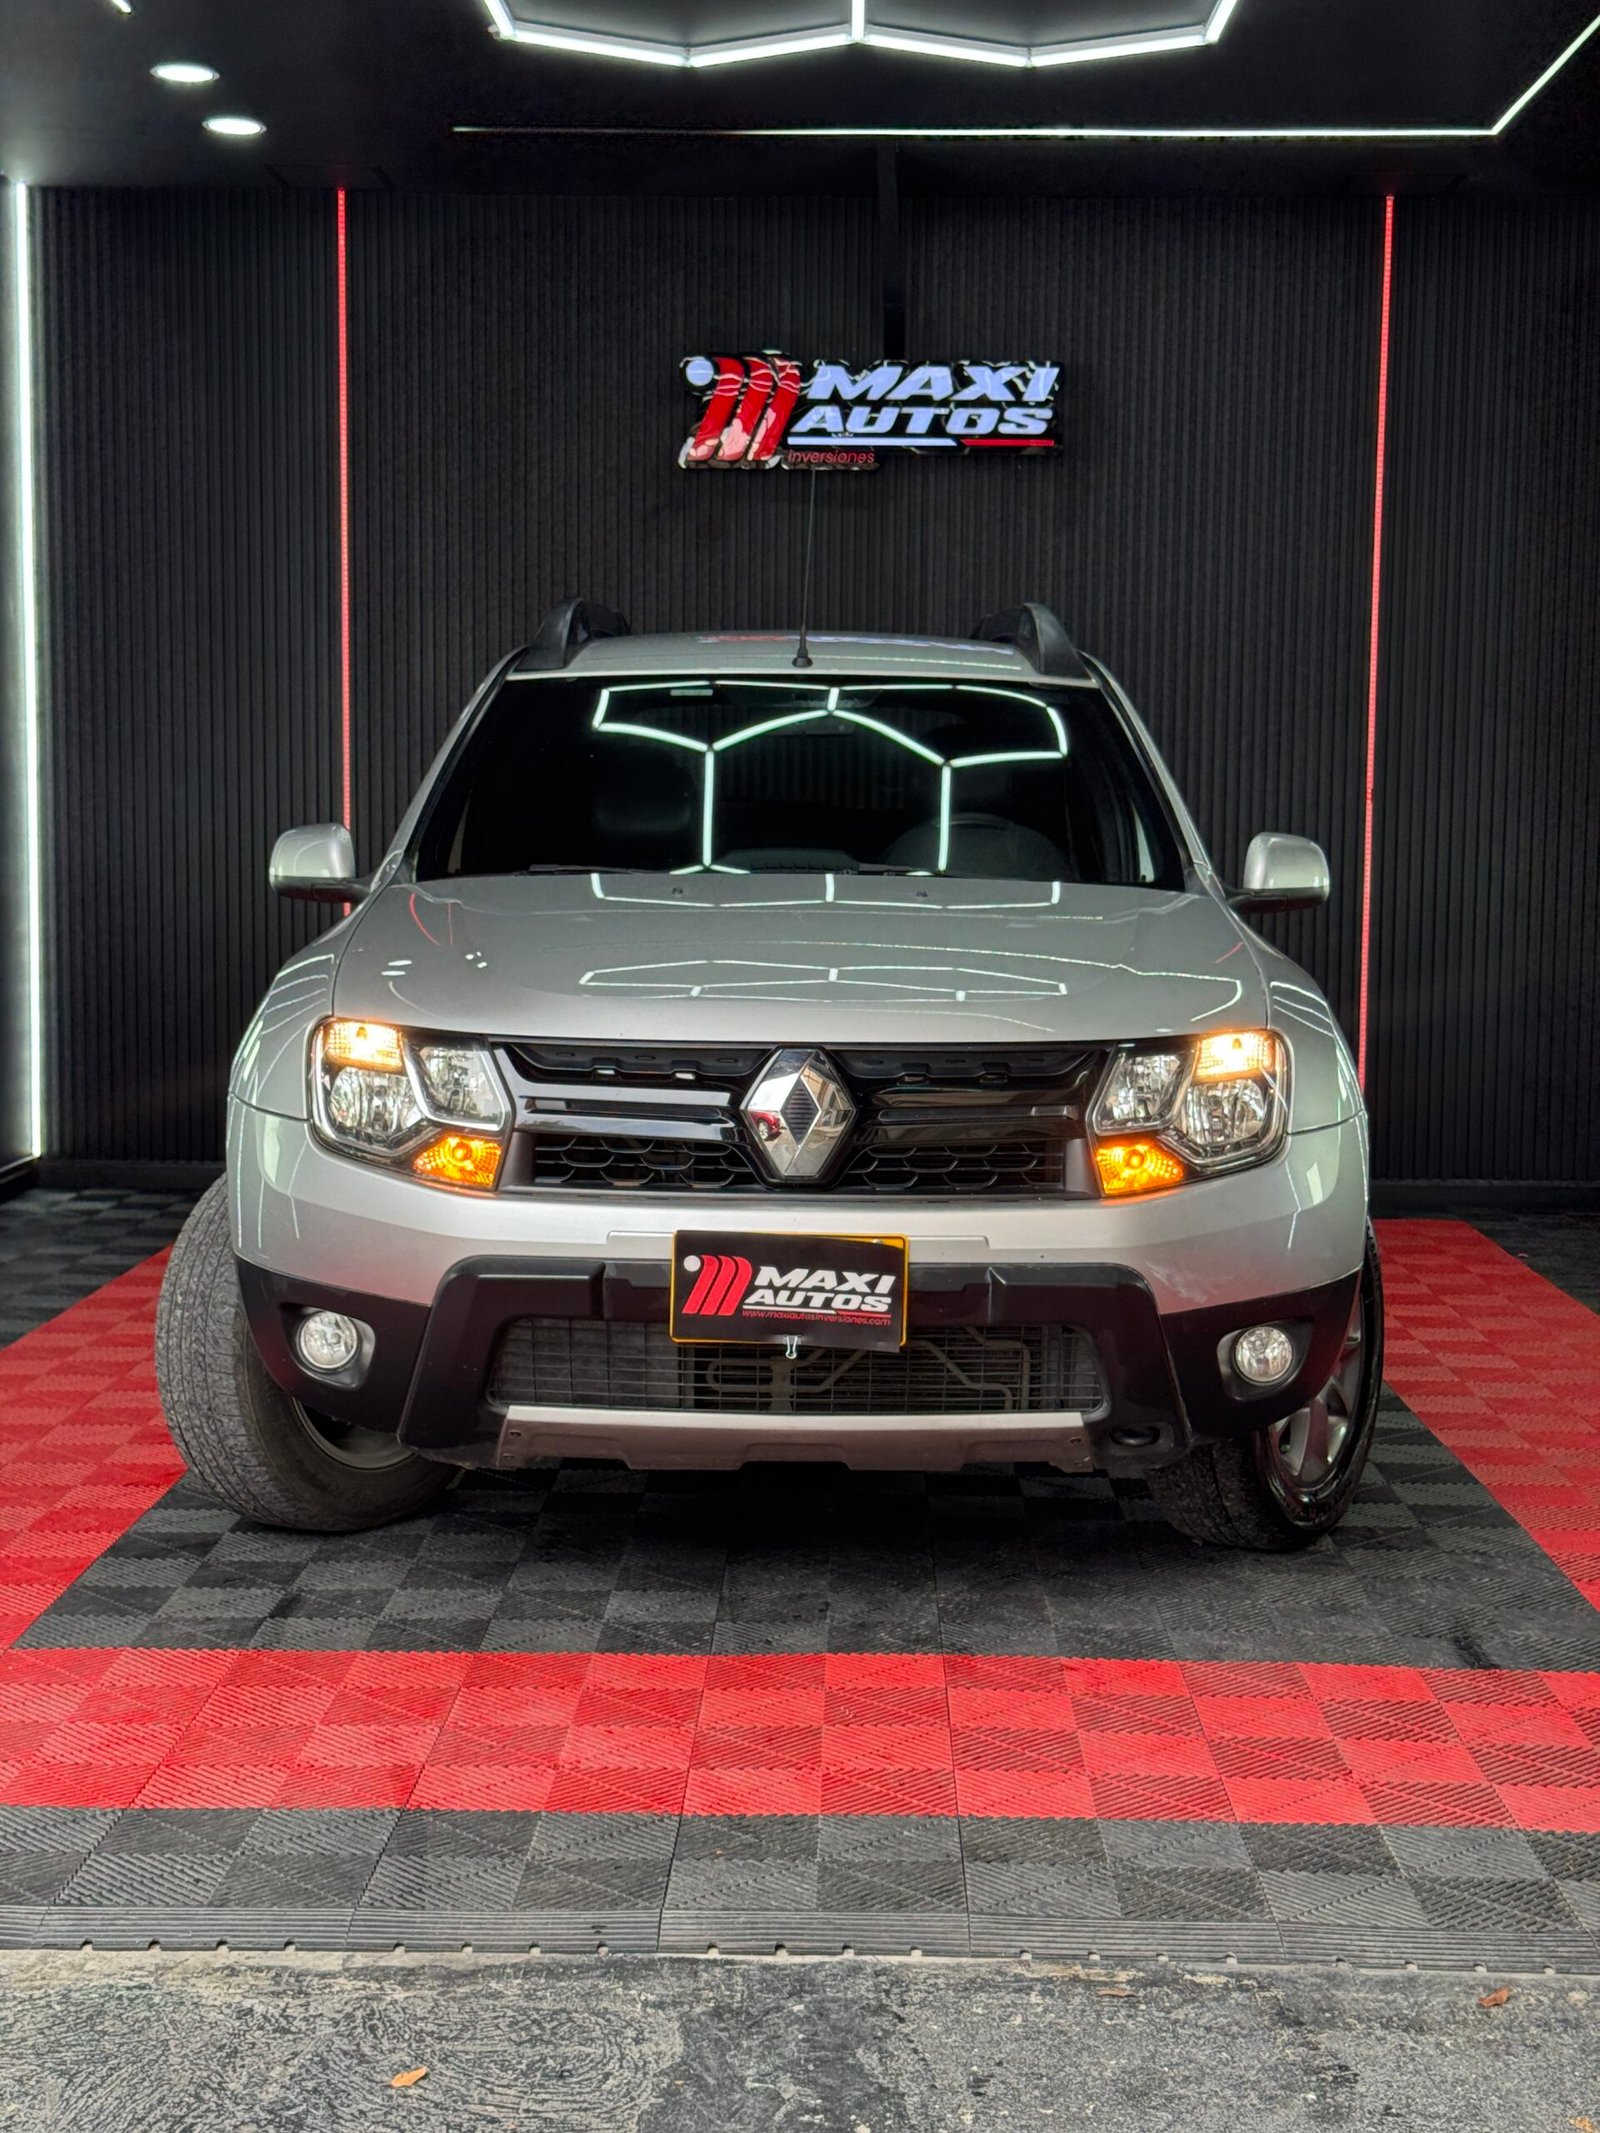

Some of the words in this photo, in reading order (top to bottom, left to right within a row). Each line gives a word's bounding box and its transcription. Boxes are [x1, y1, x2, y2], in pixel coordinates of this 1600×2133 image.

[806, 365, 1060, 402] MAXI
[789, 405, 1054, 435] AUTOS
[787, 449, 876, 464] inversiones
[754, 1266, 896, 1294] MAXI
[745, 1289, 892, 1312] AUTOS
[741, 1310, 891, 1326] www.maxiautosinversiones.com
